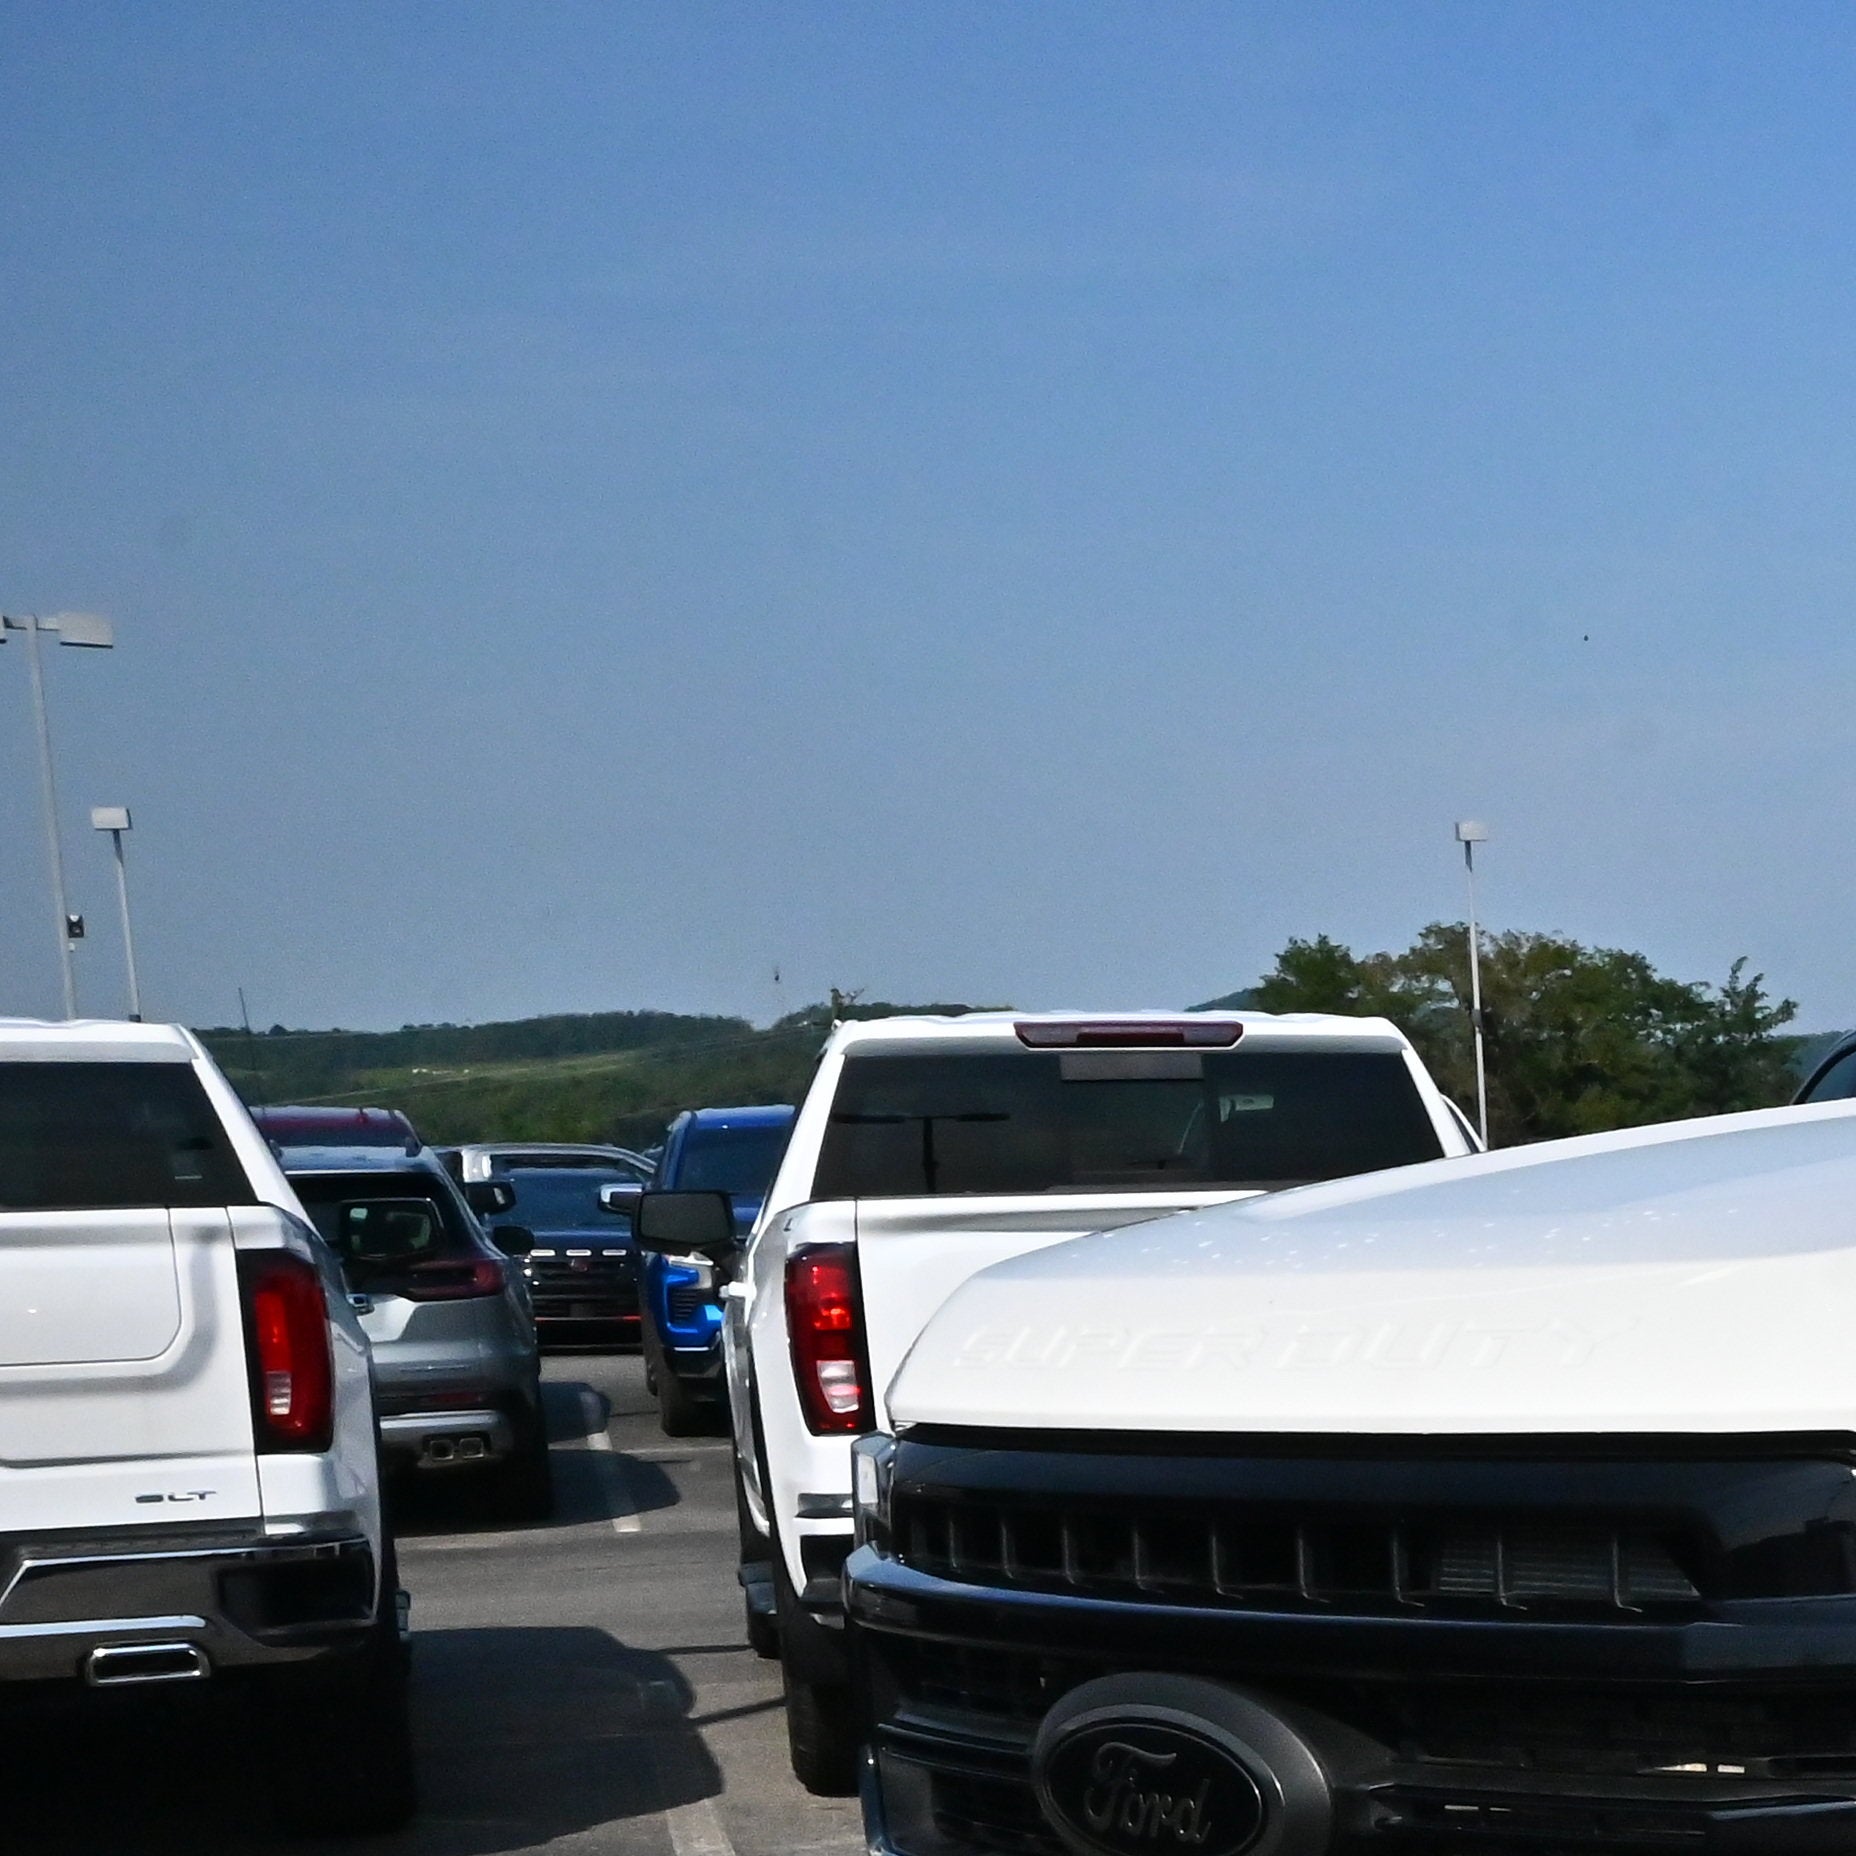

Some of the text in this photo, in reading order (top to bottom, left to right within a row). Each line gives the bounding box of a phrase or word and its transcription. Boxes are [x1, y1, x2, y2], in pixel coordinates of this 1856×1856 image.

[957, 1315, 1638, 1372] SUPER DUTY
[1084, 1740, 1212, 1844] Ford
